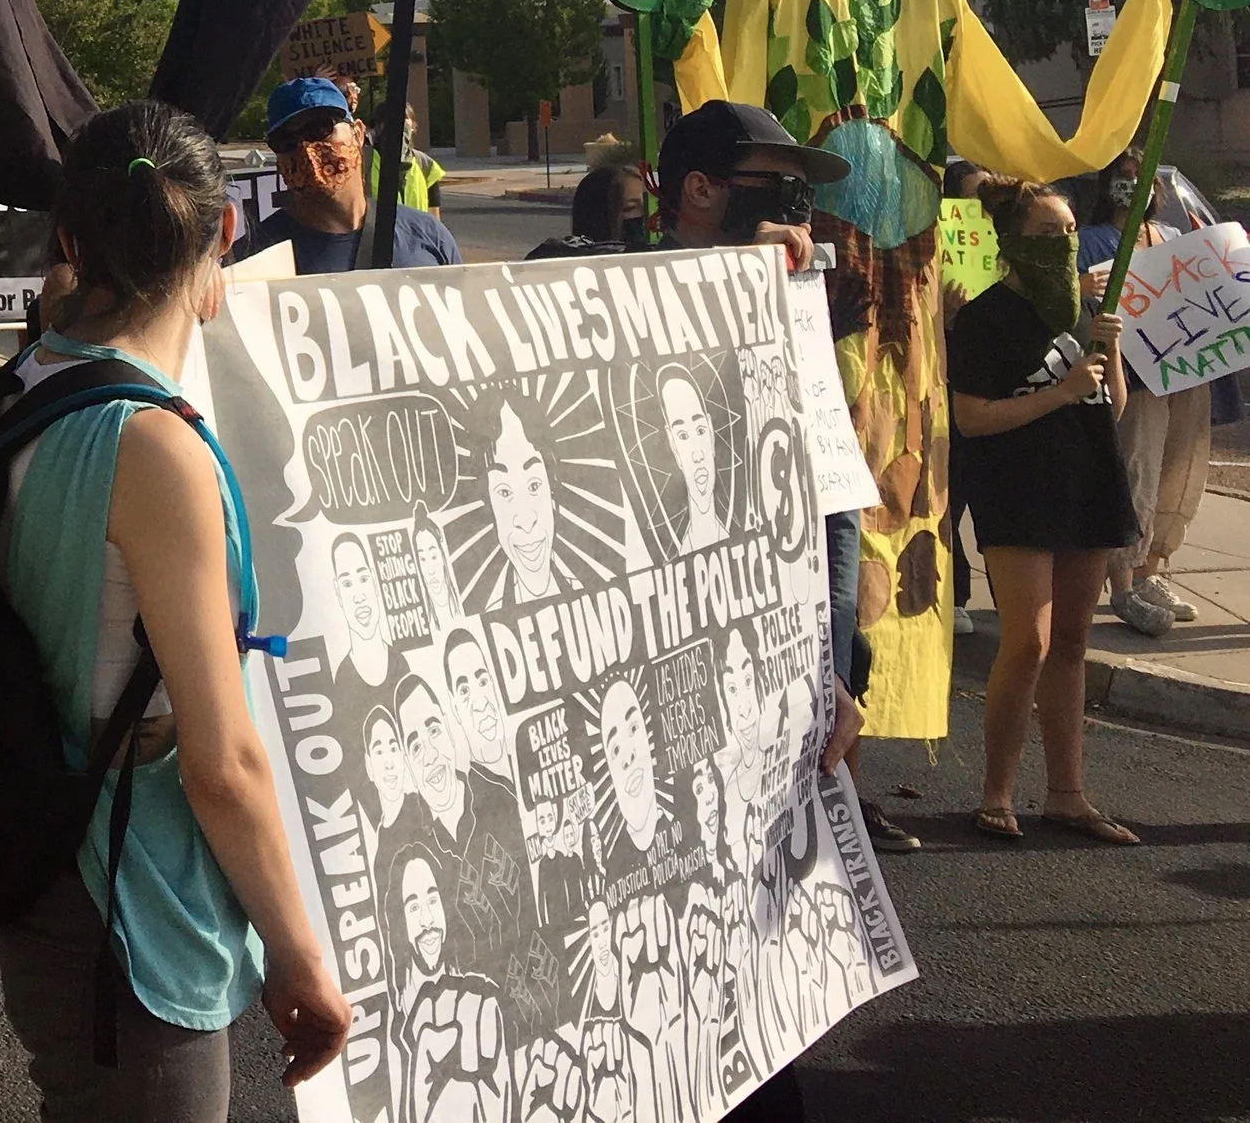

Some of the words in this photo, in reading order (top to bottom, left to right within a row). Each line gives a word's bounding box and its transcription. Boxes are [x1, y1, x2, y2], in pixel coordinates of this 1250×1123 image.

[291, 18, 350, 41] WHITE
[291, 36, 367, 61] SILENCE
[294, 57, 378, 77] VIENCE
[1118, 239, 1250, 318] BLACK
[278, 283, 496, 403] BLACK
[1159, 326, 1250, 392] MATT
[386, 408, 446, 503] OUT
[375, 531, 403, 557] STOP
[381, 577, 421, 610] BLACK
[490, 587, 633, 704] DEFUND
[628, 561, 693, 660] THE
[693, 535, 779, 629] POLICE
[760, 603, 803, 653] POLICE
[655, 663, 675, 706] LAS
[672, 646, 708, 698] VIDAS
[759, 634, 815, 698] BRUTALITY
[278, 645, 344, 776] OUT
[528, 707, 569, 753] BLACK
[660, 692, 706, 744] NEGRAS
[538, 736, 571, 768] LIVES
[665, 716, 720, 774] IMPORTAN
[527, 754, 587, 803] MATTER
[646, 846, 657, 868] NO
[671, 820, 683, 848] NO
[827, 803, 870, 887] TRANS
[305, 788, 381, 980] SPEAK
[606, 883, 618, 911] NO
[857, 887, 900, 973] BLACK
